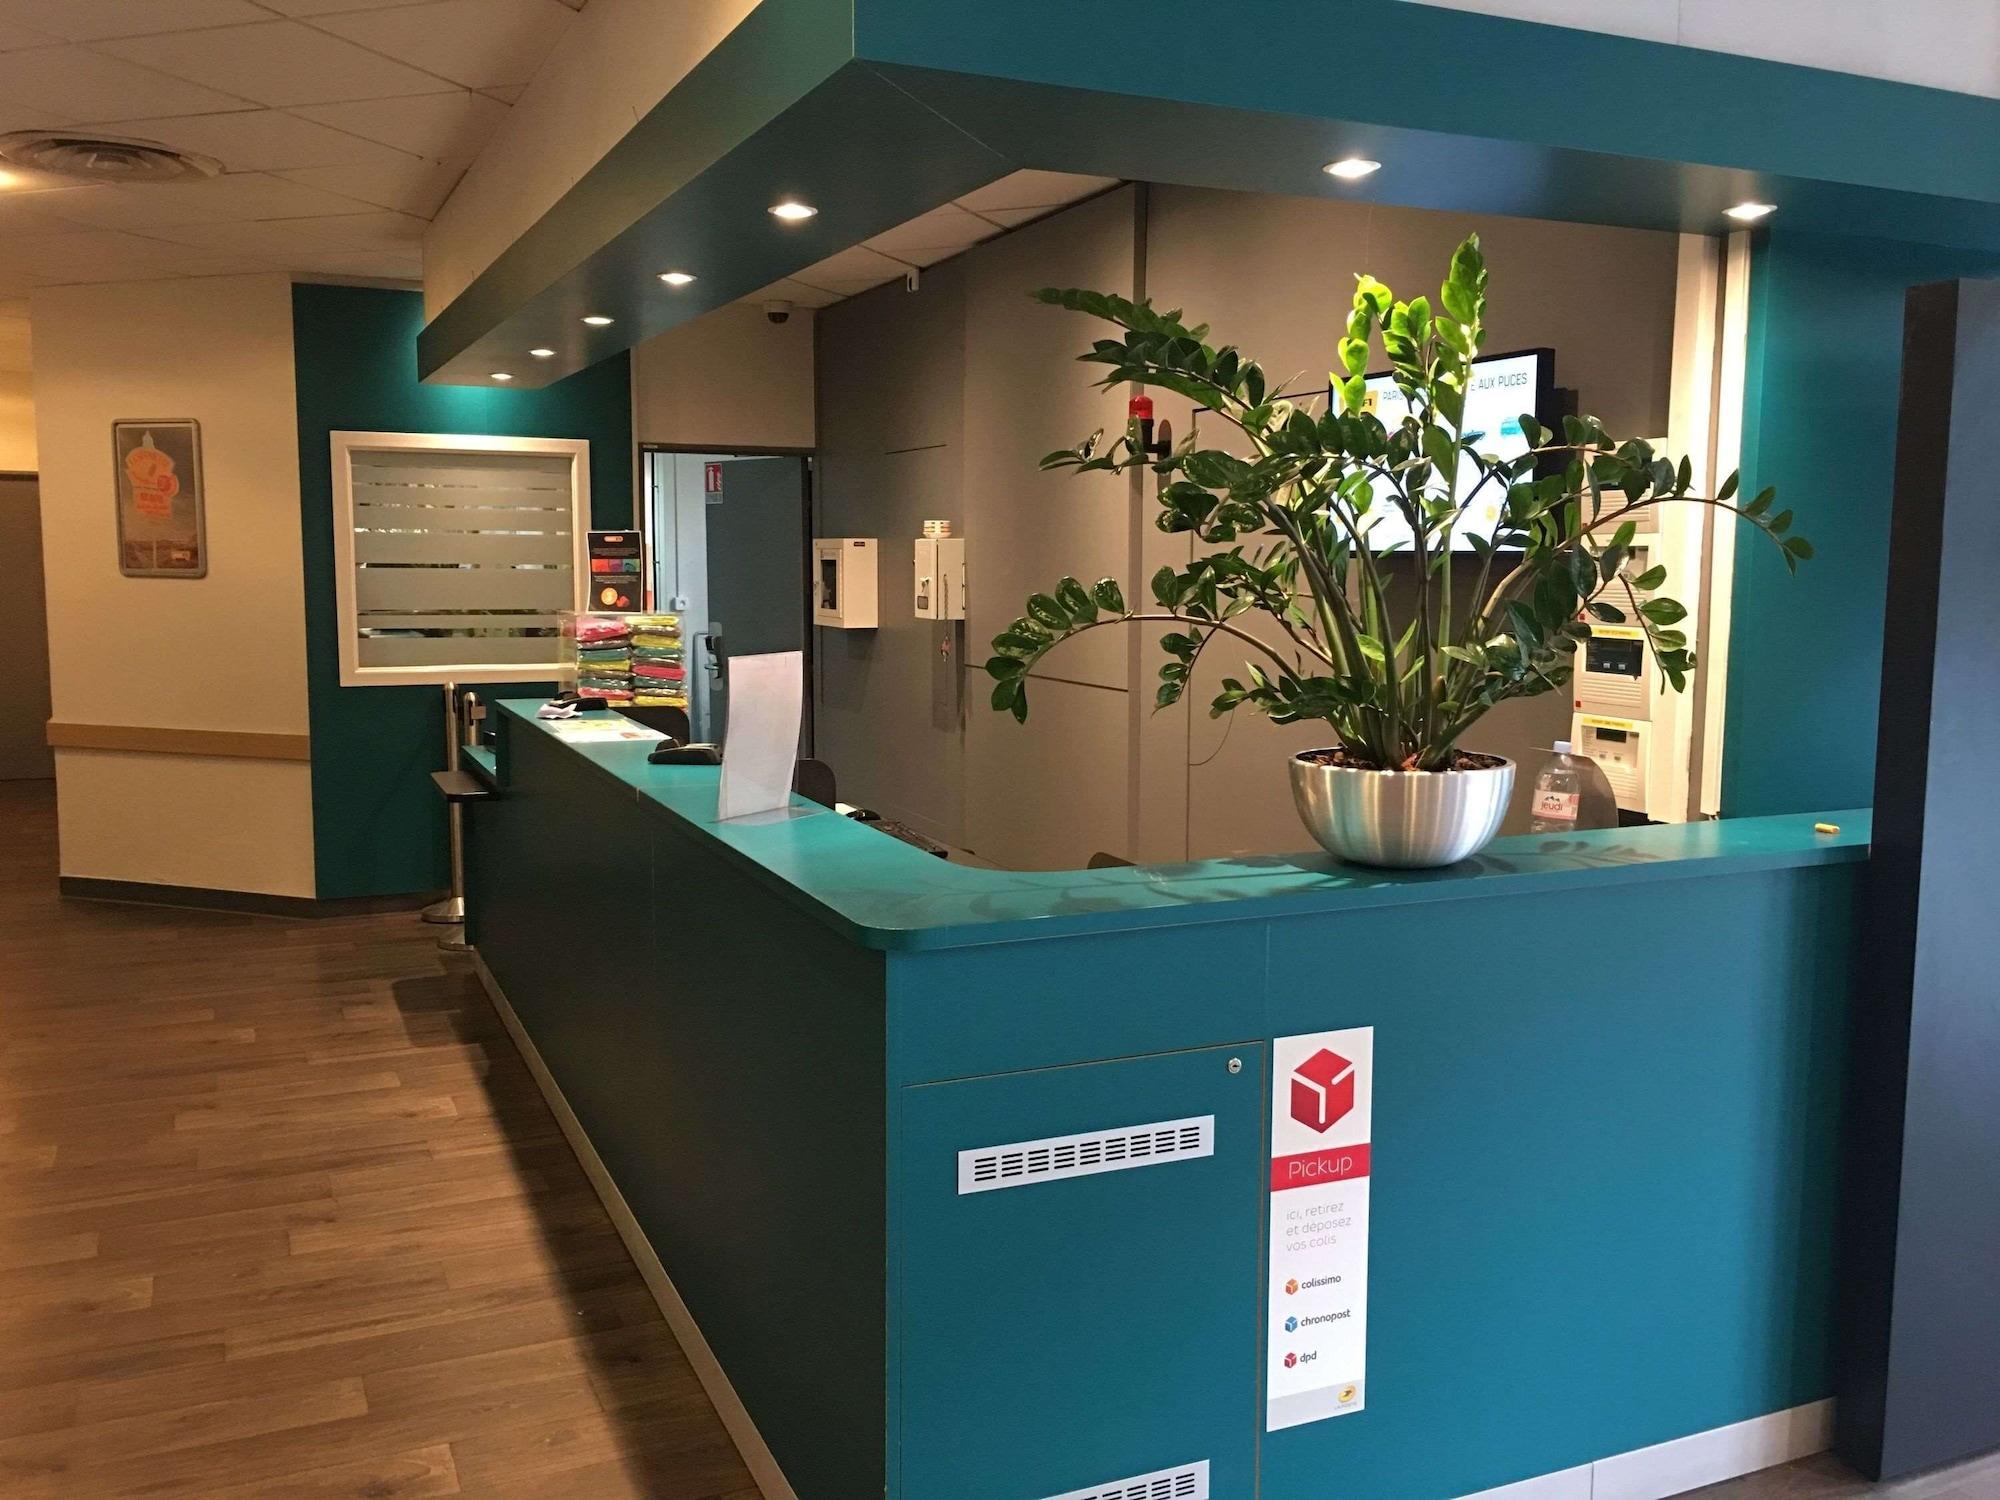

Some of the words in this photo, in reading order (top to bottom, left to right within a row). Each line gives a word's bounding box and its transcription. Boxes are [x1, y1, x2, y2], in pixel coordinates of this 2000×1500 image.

[1478, 376, 1496, 390] AUX
[1498, 372, 1528, 387] PUCES
[1288, 1156, 1353, 1179] Pickup
[1305, 1202, 1344, 1217] retirez
[1286, 1225, 1299, 1237] et
[1286, 1240, 1307, 1252] vos
[1309, 1235, 1337, 1248] colis
[1301, 1274, 1342, 1290] colissimo
[1300, 1308, 1351, 1327] chronopost
[1299, 1350, 1317, 1364] dpd
